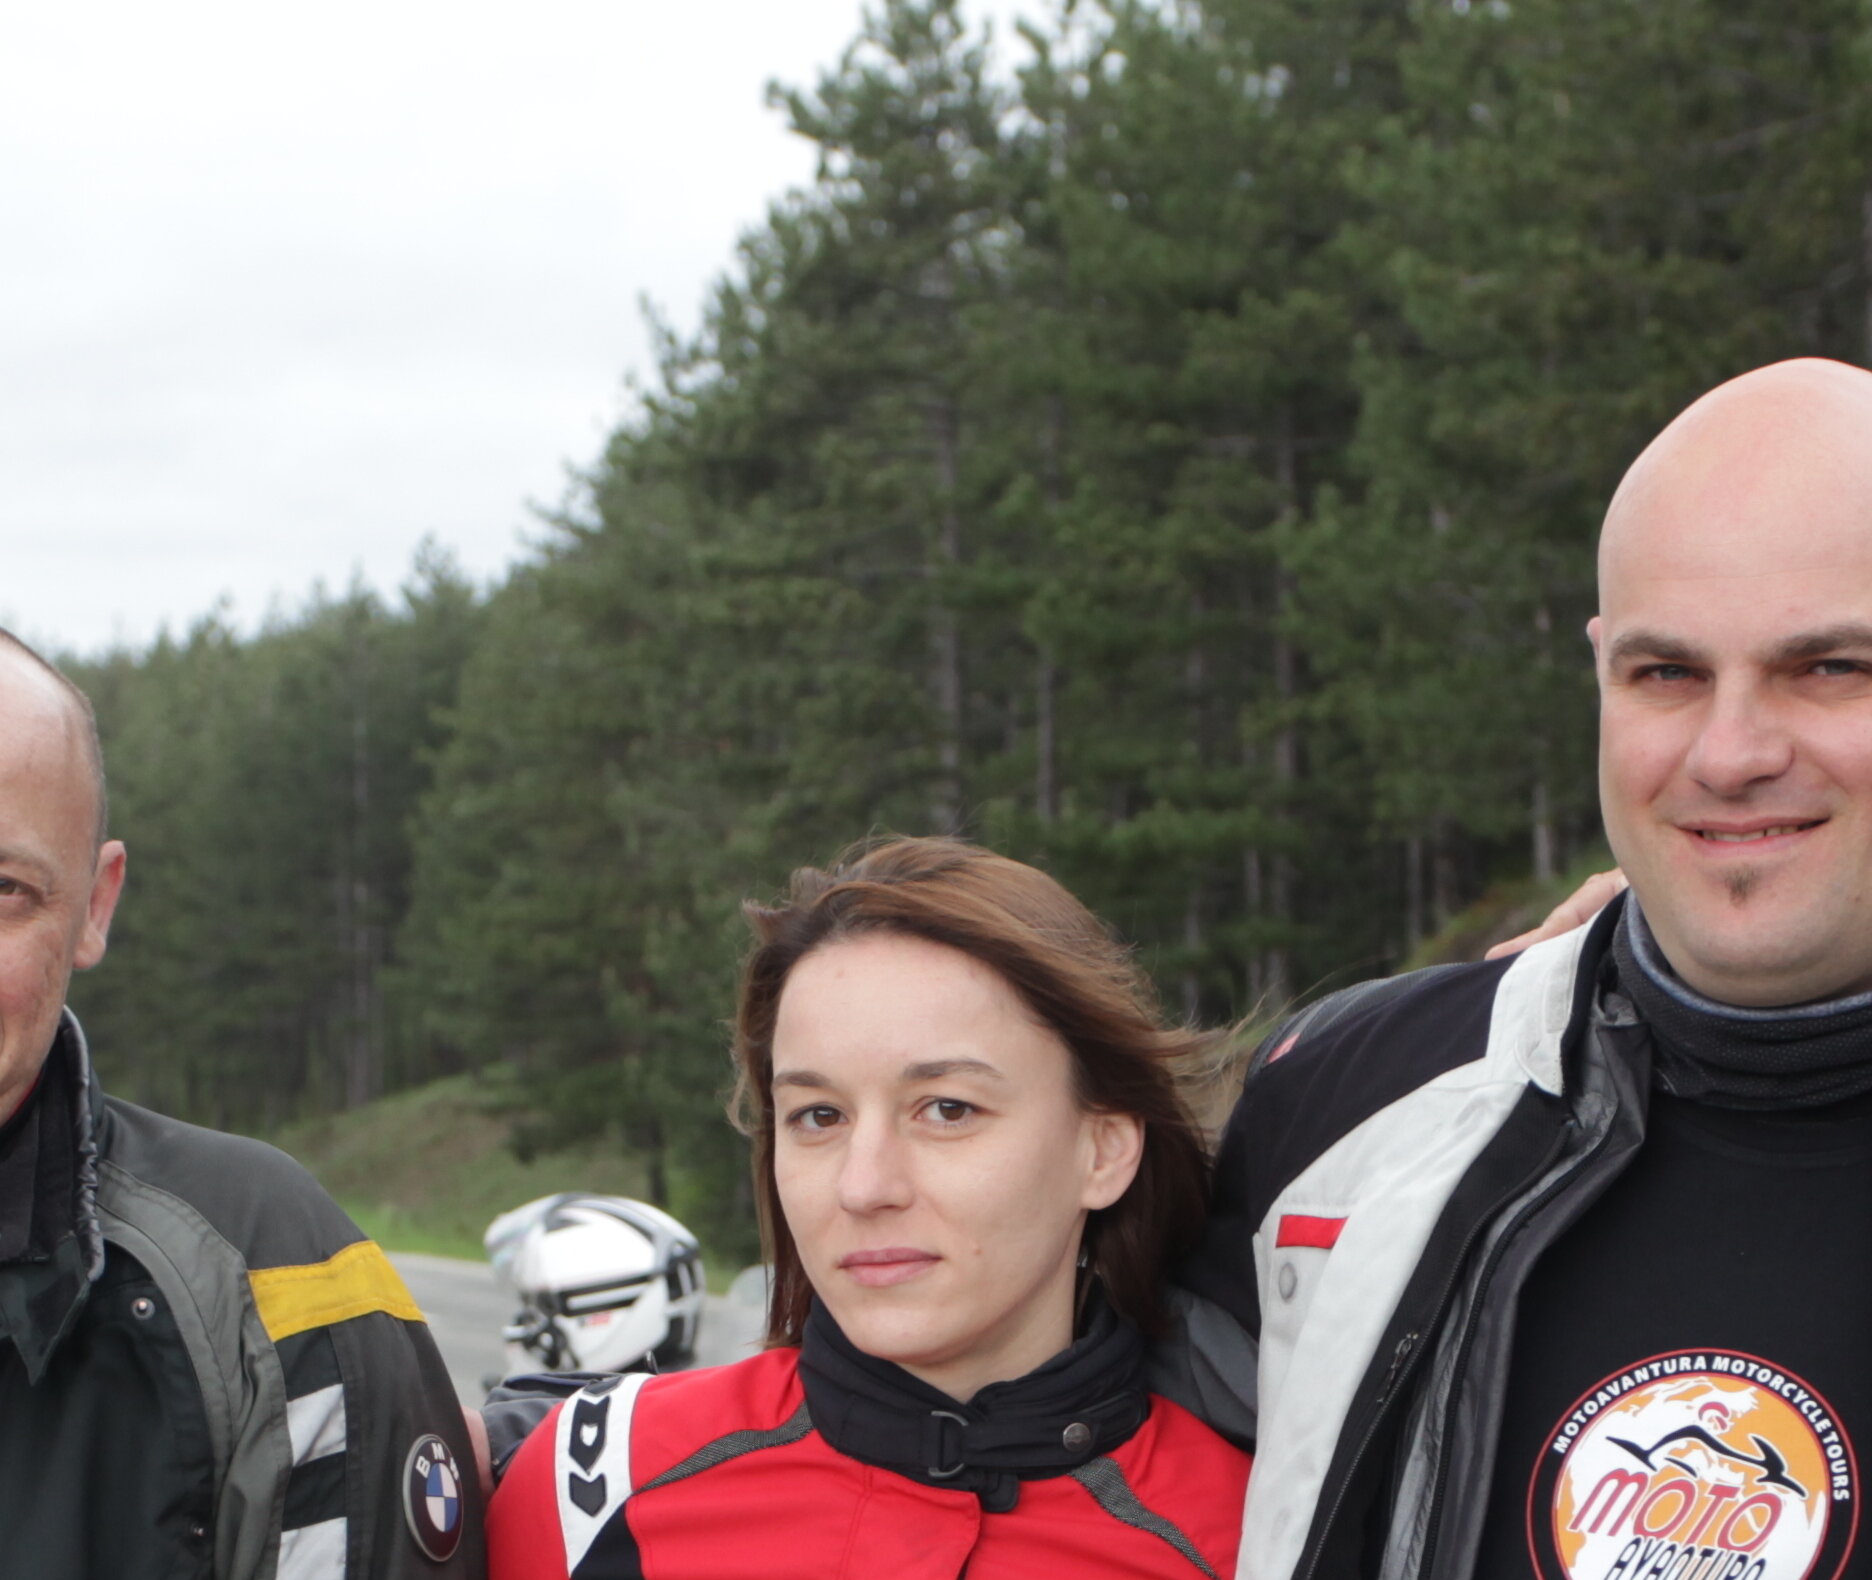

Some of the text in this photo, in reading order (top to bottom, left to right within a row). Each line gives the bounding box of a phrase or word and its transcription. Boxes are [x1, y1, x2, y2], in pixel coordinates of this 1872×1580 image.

[415, 1442, 460, 1481] BMW
[1553, 1355, 1850, 1501] MOTOAVANTURA MOTORCYCLE TOURS
[1569, 1468, 1783, 1553] MOTO
